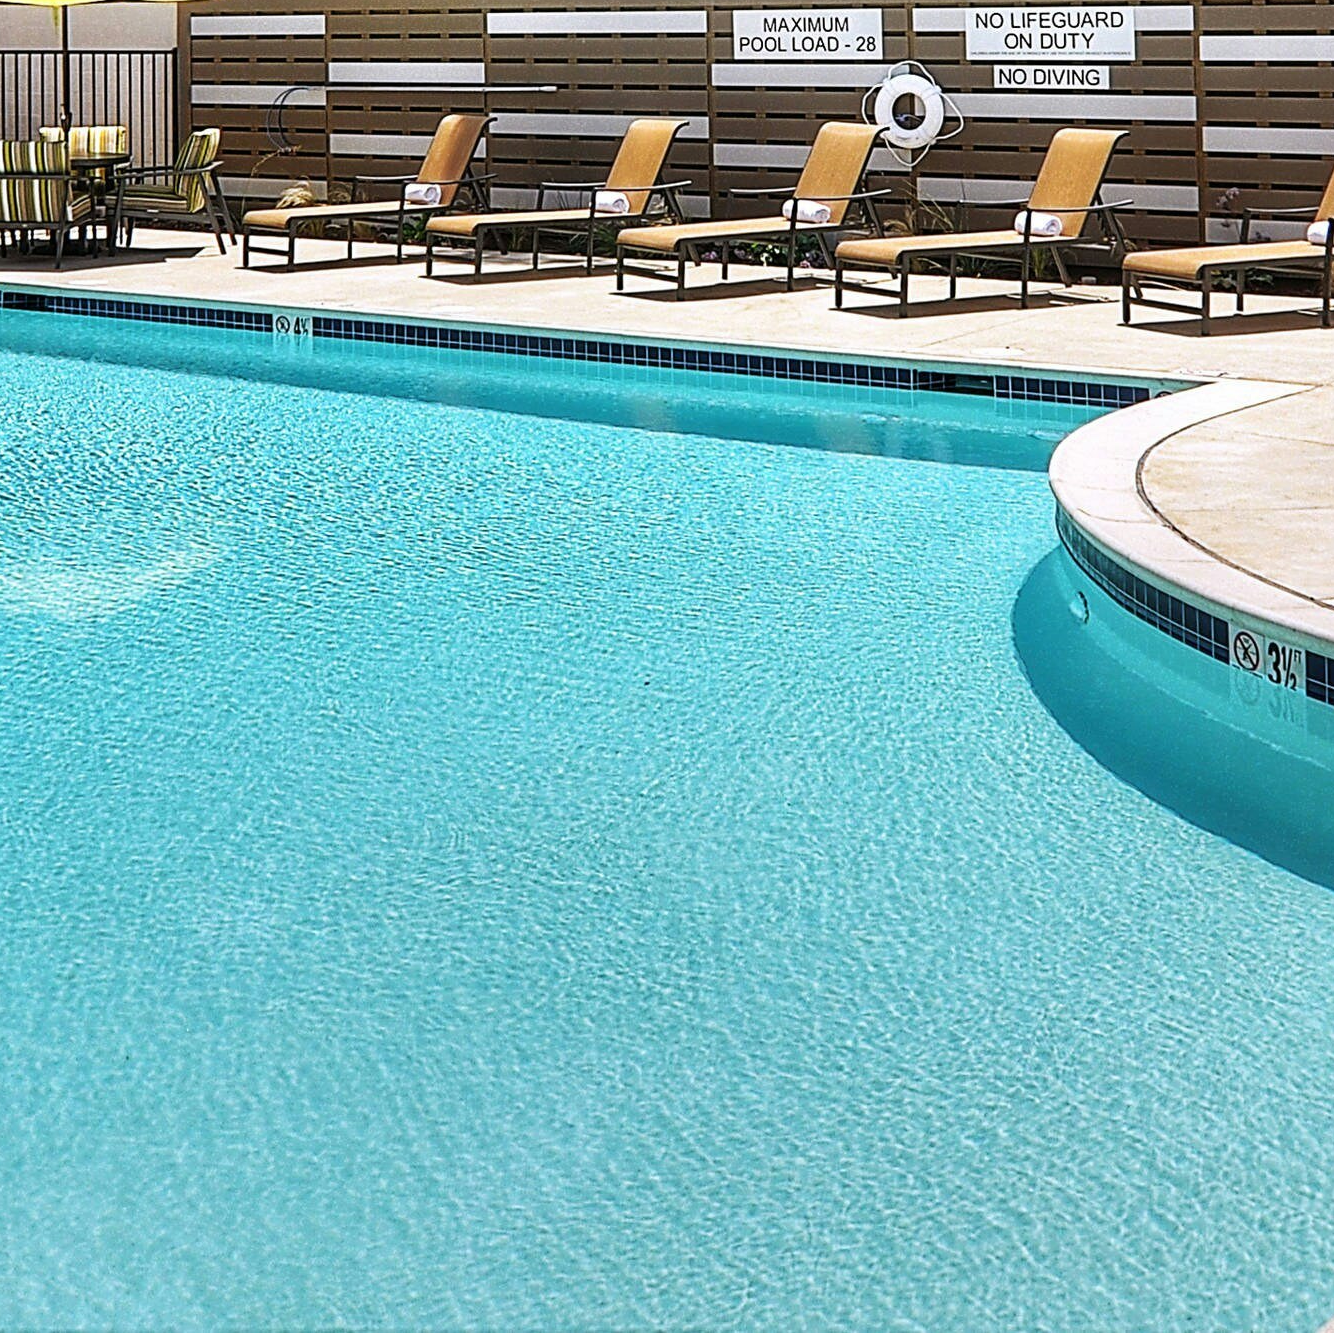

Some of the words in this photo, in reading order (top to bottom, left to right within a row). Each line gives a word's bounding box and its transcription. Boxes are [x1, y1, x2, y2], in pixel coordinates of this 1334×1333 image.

[763, 16, 849, 33] MAXIMUM
[976, 13, 1004, 29] NO
[1010, 11, 1124, 29] LIFEGUARD
[739, 36, 787, 53] POOL
[791, 36, 840, 53] LOAD
[856, 35, 877, 53] 28
[1004, 33, 1034, 50] ON
[1039, 32, 1095, 50] DUTY
[999, 69, 1027, 84] NO
[1033, 69, 1100, 86] DIVING
